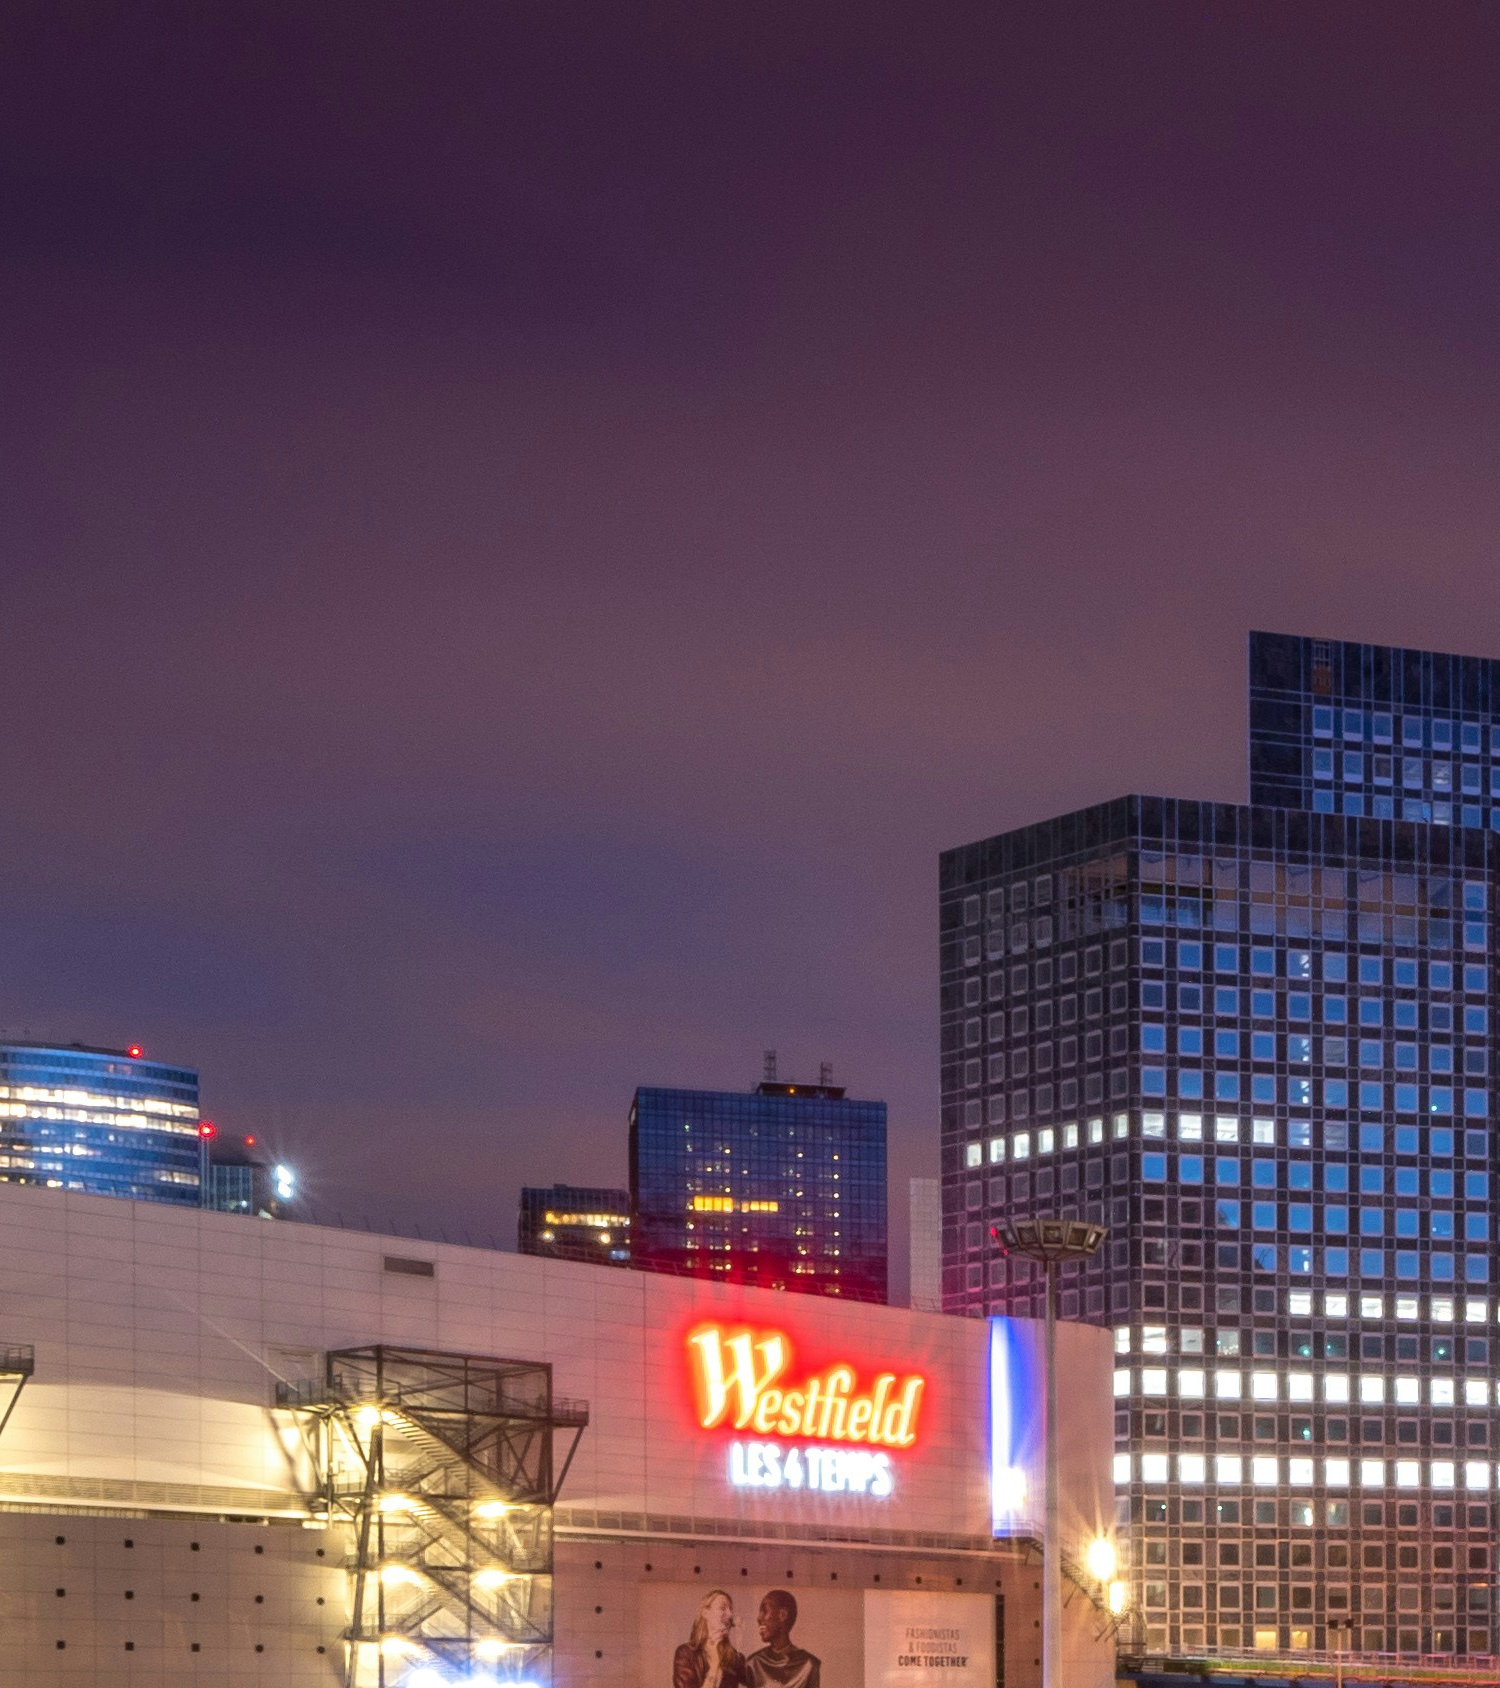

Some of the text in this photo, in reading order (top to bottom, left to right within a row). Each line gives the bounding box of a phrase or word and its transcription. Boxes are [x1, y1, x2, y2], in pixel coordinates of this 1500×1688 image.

[690, 1328, 925, 1446] Westfield
[731, 1442, 892, 1497] LES 4 TEMPS
[898, 1655, 922, 1667] COME
